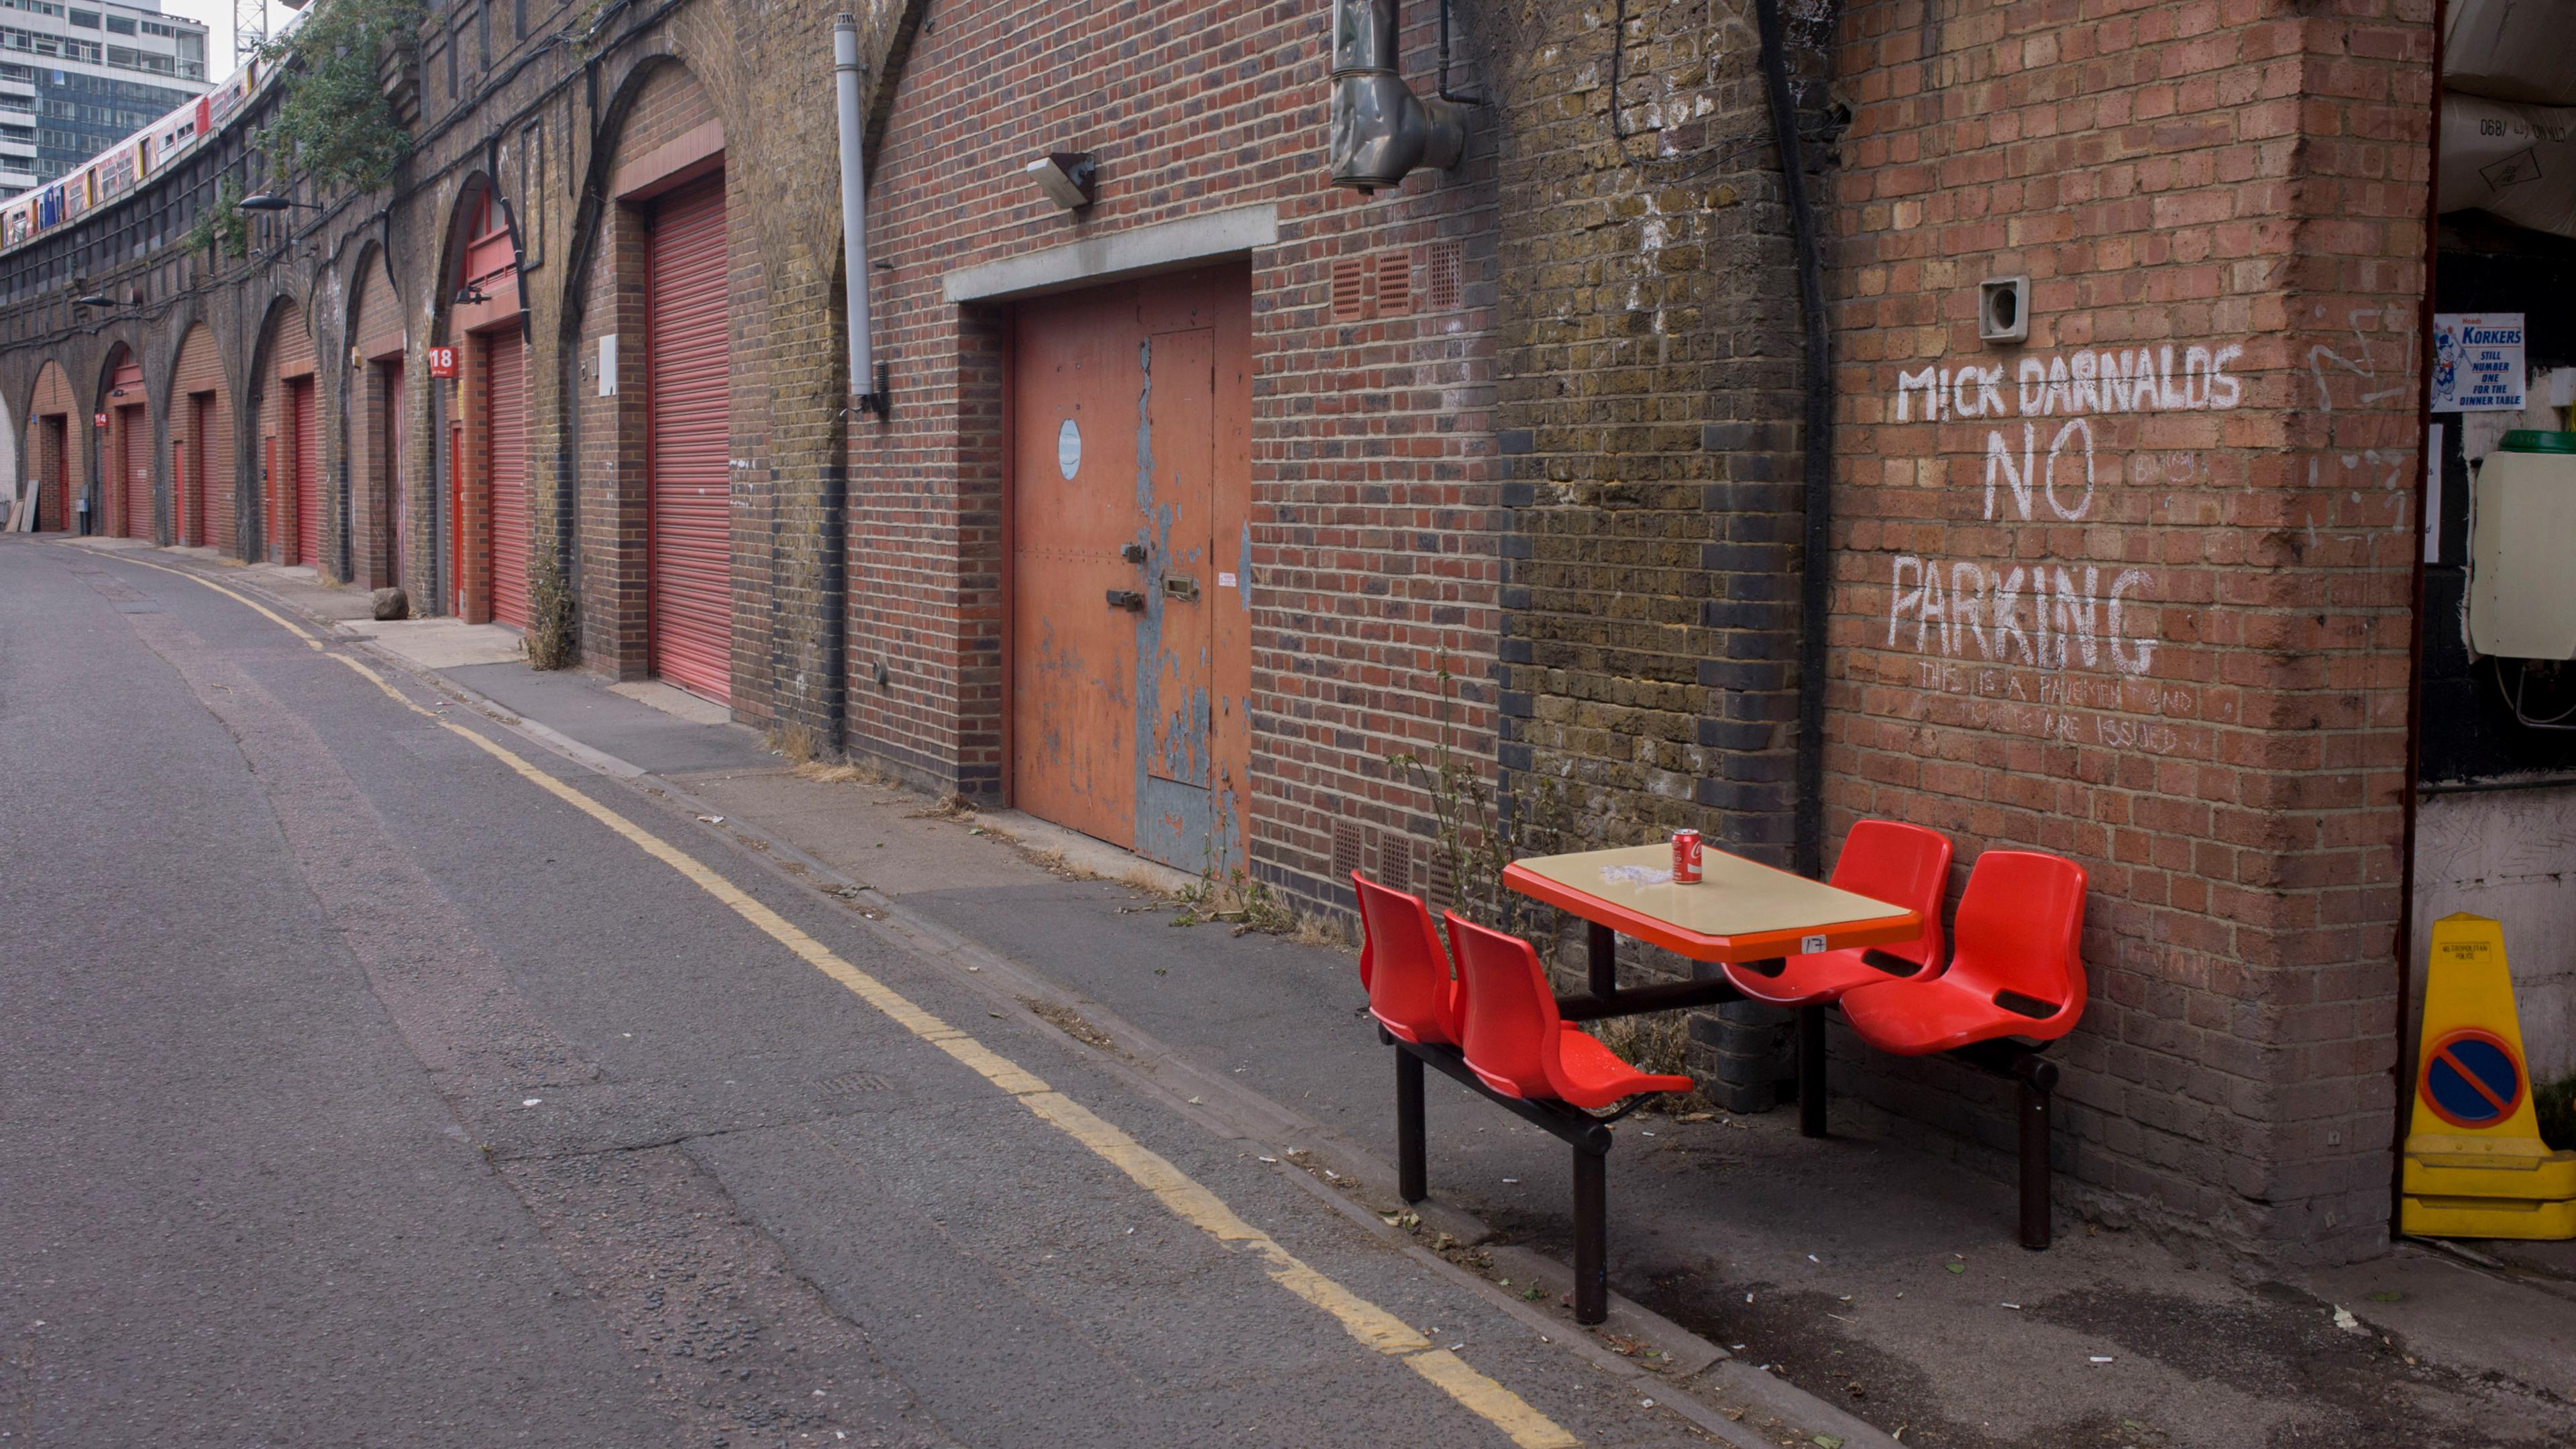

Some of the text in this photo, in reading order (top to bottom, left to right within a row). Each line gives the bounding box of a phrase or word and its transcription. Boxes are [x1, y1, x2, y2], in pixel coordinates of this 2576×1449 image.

[2462, 327, 2522, 344] KORKERS
[429, 349, 452, 368] 118
[2481, 351, 2501, 360] STILL
[2471, 362, 2510, 371] NUMBER
[1896, 343, 2243, 423] MICK DARNALDS
[2481, 374, 2500, 382] ONE
[2473, 384, 2508, 394] FOR THE
[2459, 396, 2522, 405] DINNER TABLE
[95, 413, 107, 423] 114
[1984, 418, 2095, 521] NO
[1888, 554, 2159, 675] PARKING
[1919, 661, 1962, 692] THIS
[1980, 669, 1996, 696] IS
[2008, 676, 2027, 702] A
[2147, 688, 2192, 712] AND
[2043, 711, 2080, 742] ARE
[2094, 715, 2178, 754] ISSUED
[1806, 938, 1825, 953] 17
[2443, 944, 2488, 952] METROPOLITAN
